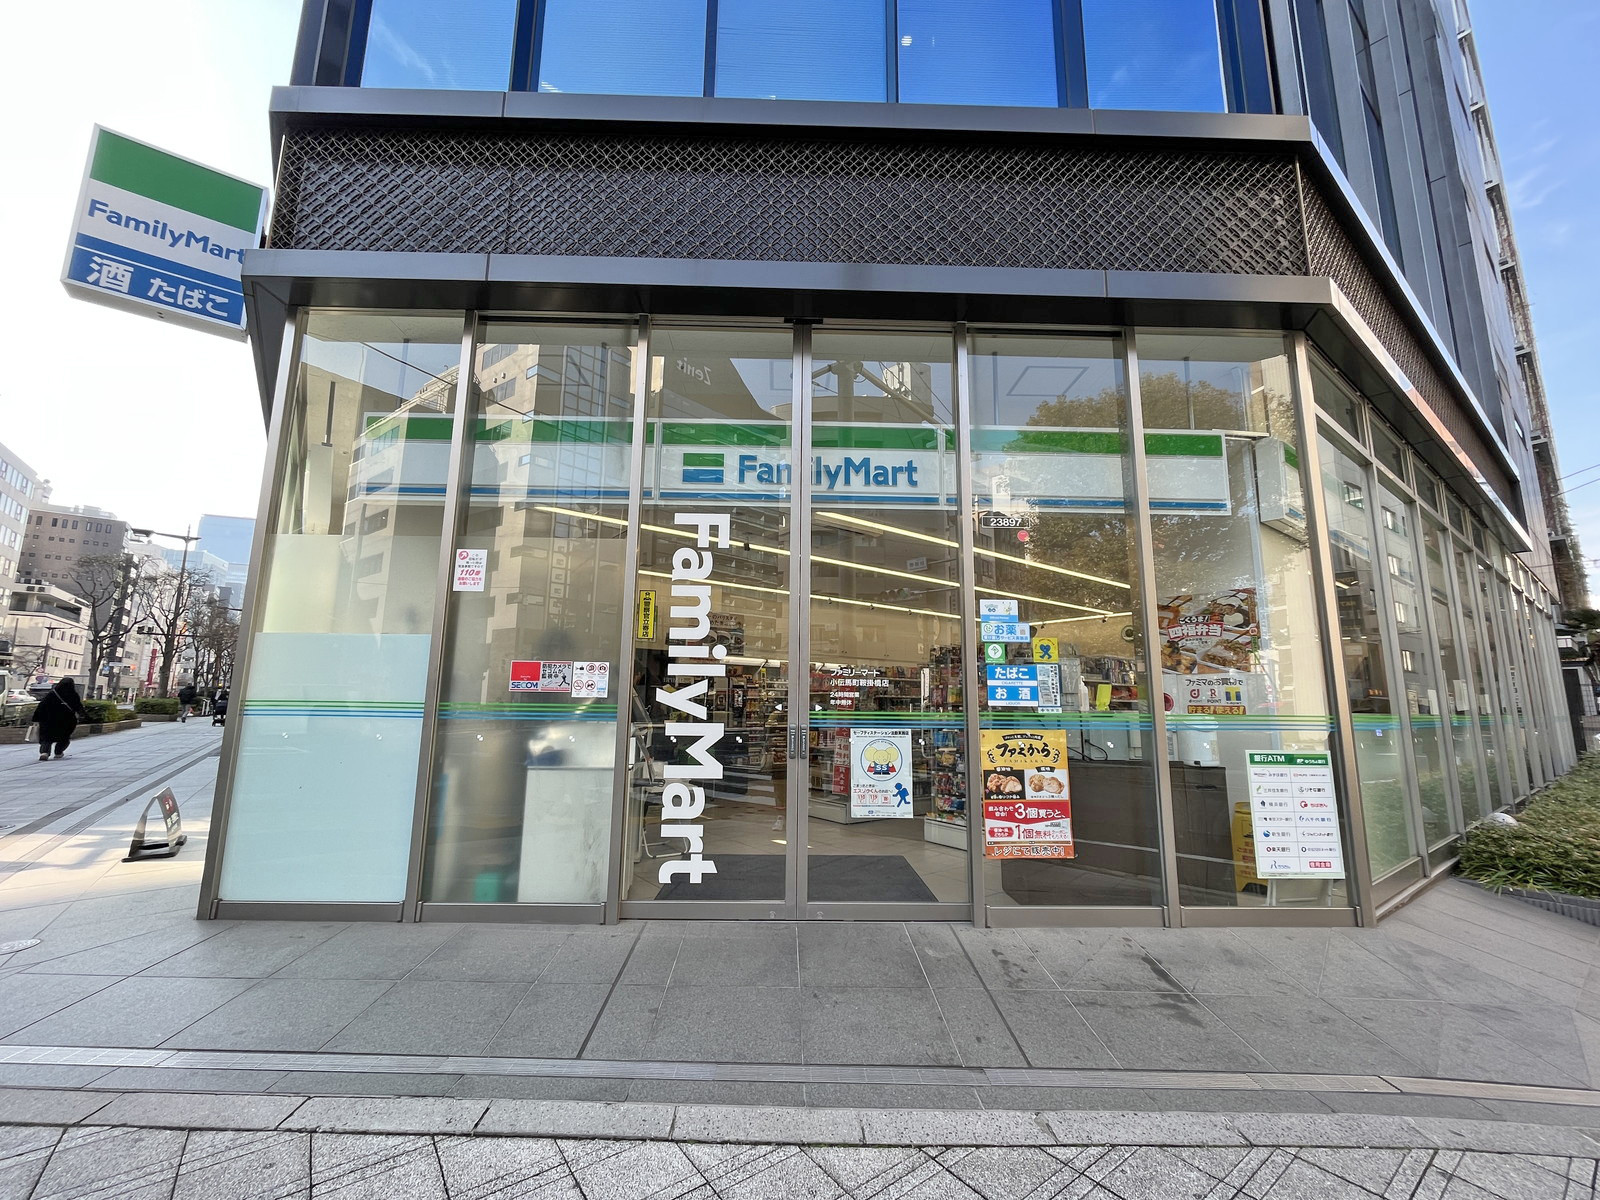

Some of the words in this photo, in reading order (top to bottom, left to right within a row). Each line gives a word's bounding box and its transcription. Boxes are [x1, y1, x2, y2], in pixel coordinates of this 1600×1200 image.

[87, 199, 245, 265] FamilyMart
[86, 255, 134, 294] 酒
[147, 275, 230, 318] たばこ
[738, 454, 918, 490] FamlyMart
[990, 518, 1022, 527] 23897
[830, 668, 881, 677] ファミリーマート
[995, 667, 1029, 679] たばこ
[656, 512, 730, 884] FamilyMart
[995, 742, 1051, 758] ファミから
[1254, 755, 1285, 763] 銀行ATM
